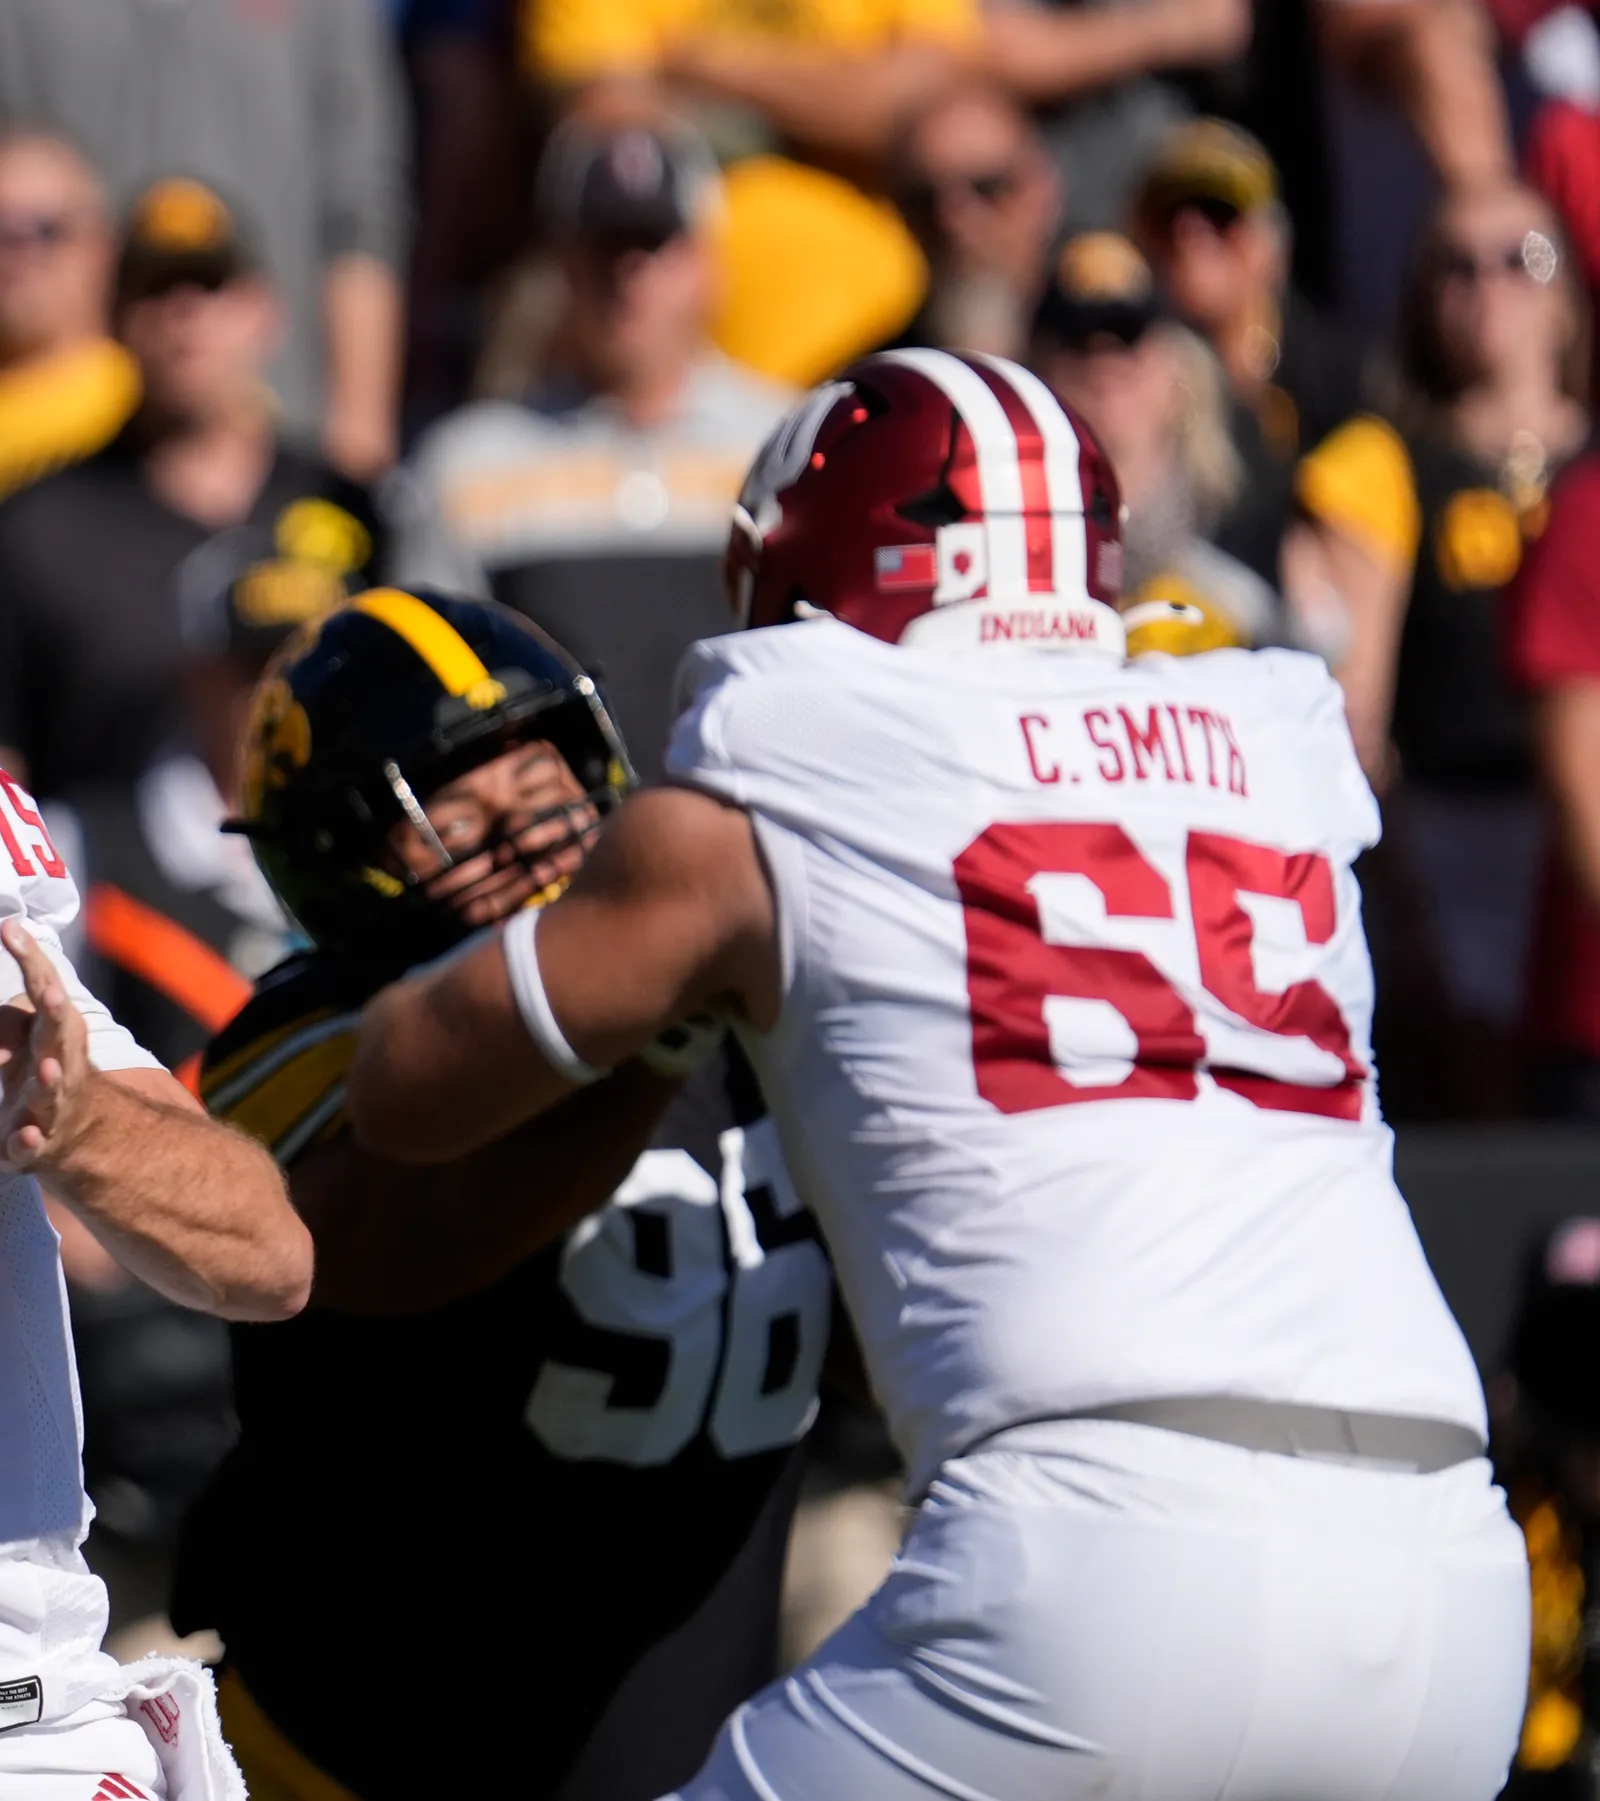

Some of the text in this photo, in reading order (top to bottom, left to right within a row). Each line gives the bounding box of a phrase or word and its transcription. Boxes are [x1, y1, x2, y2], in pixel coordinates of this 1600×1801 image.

[979, 609, 1097, 643] INDIANA
[952, 820, 1369, 1122] 65
[524, 1116, 832, 1468] 96
